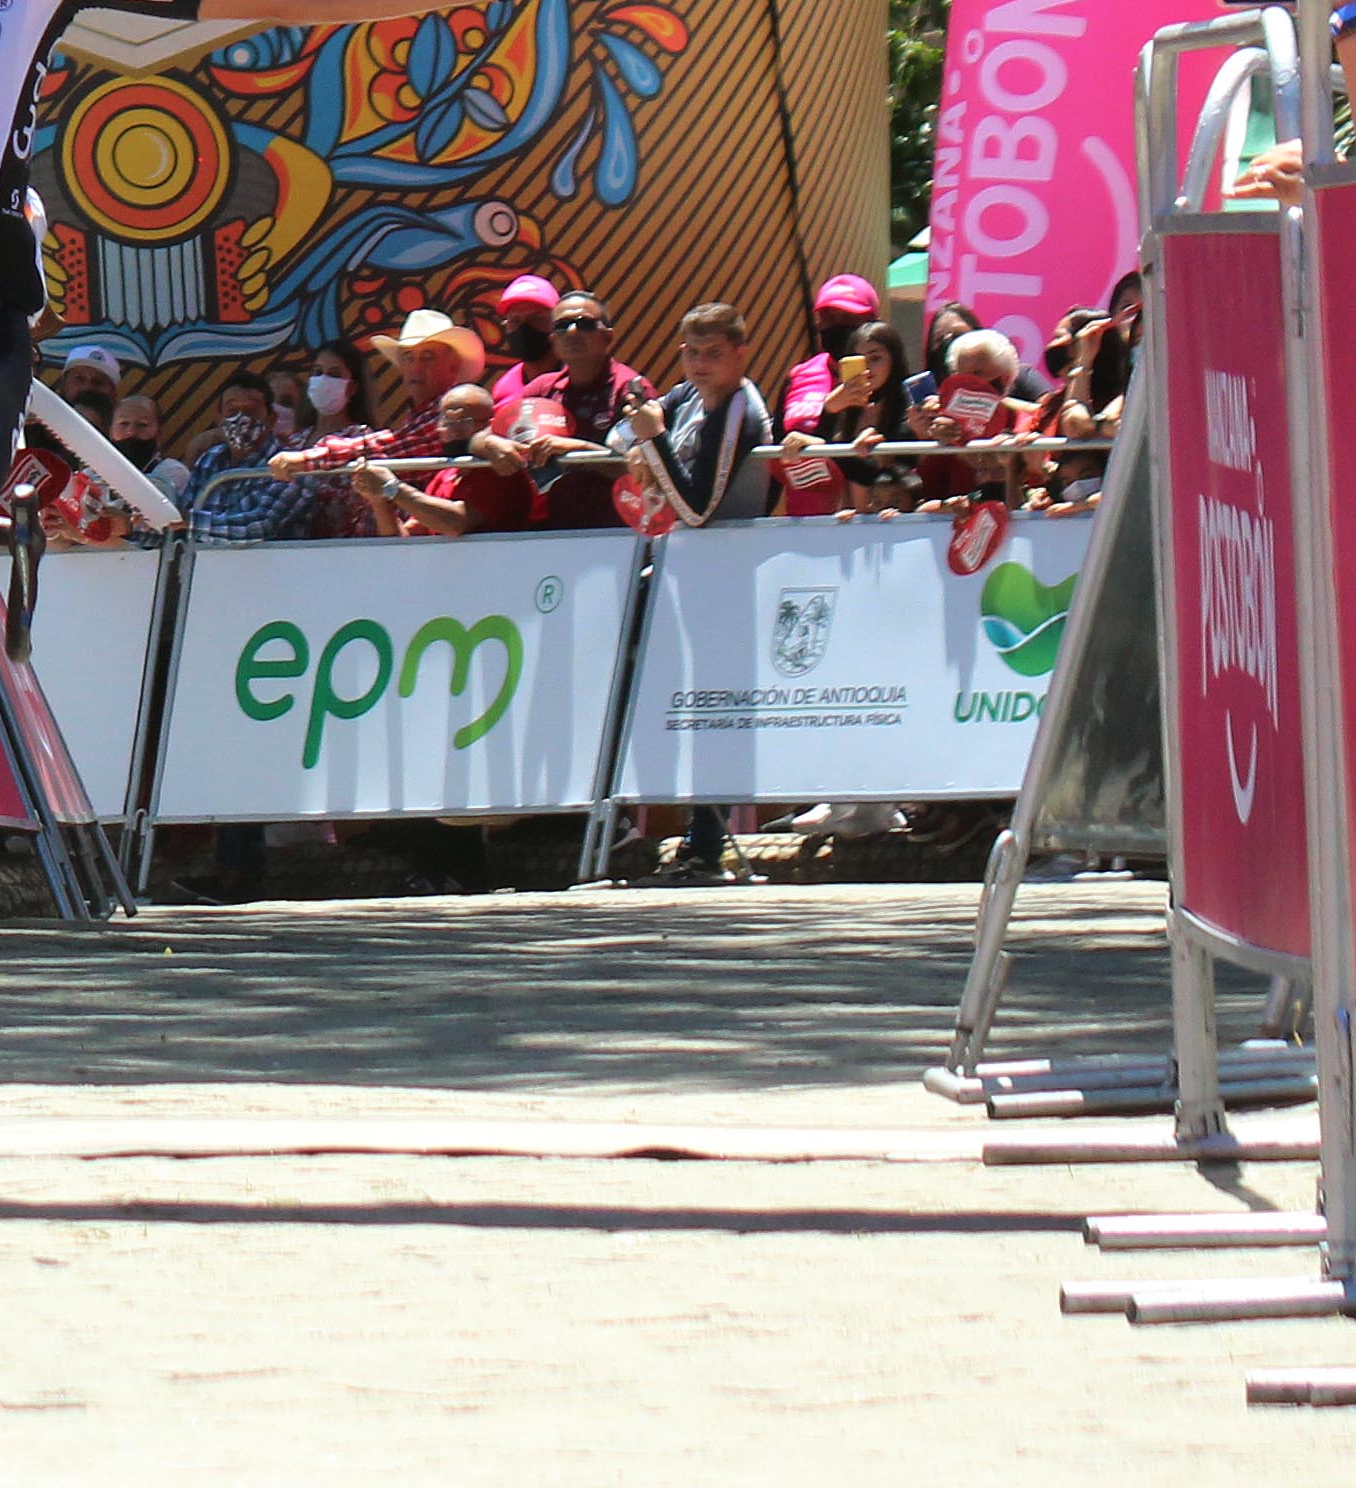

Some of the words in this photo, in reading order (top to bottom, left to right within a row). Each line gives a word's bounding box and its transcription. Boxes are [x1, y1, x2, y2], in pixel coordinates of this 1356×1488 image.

[234, 617, 525, 770] epm
[671, 683, 791, 709] GOBERNACIÓN
[793, 687, 818, 706] DE
[818, 684, 907, 705] ANTIOQUIA
